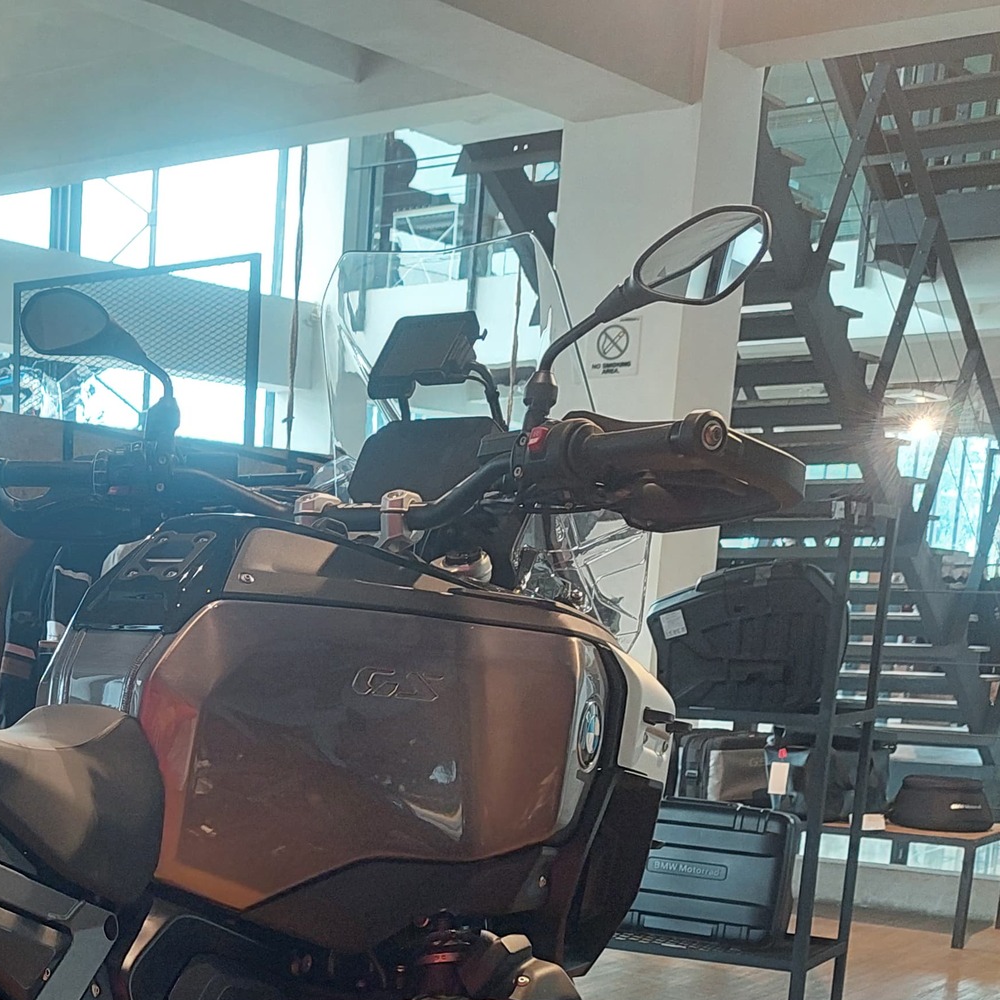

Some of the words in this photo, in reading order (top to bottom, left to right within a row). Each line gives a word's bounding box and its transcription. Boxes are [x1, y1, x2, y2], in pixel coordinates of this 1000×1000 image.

[351, 666, 444, 702] GS
[654, 861, 678, 871] BMW
[679, 864, 720, 876] Motorrad
